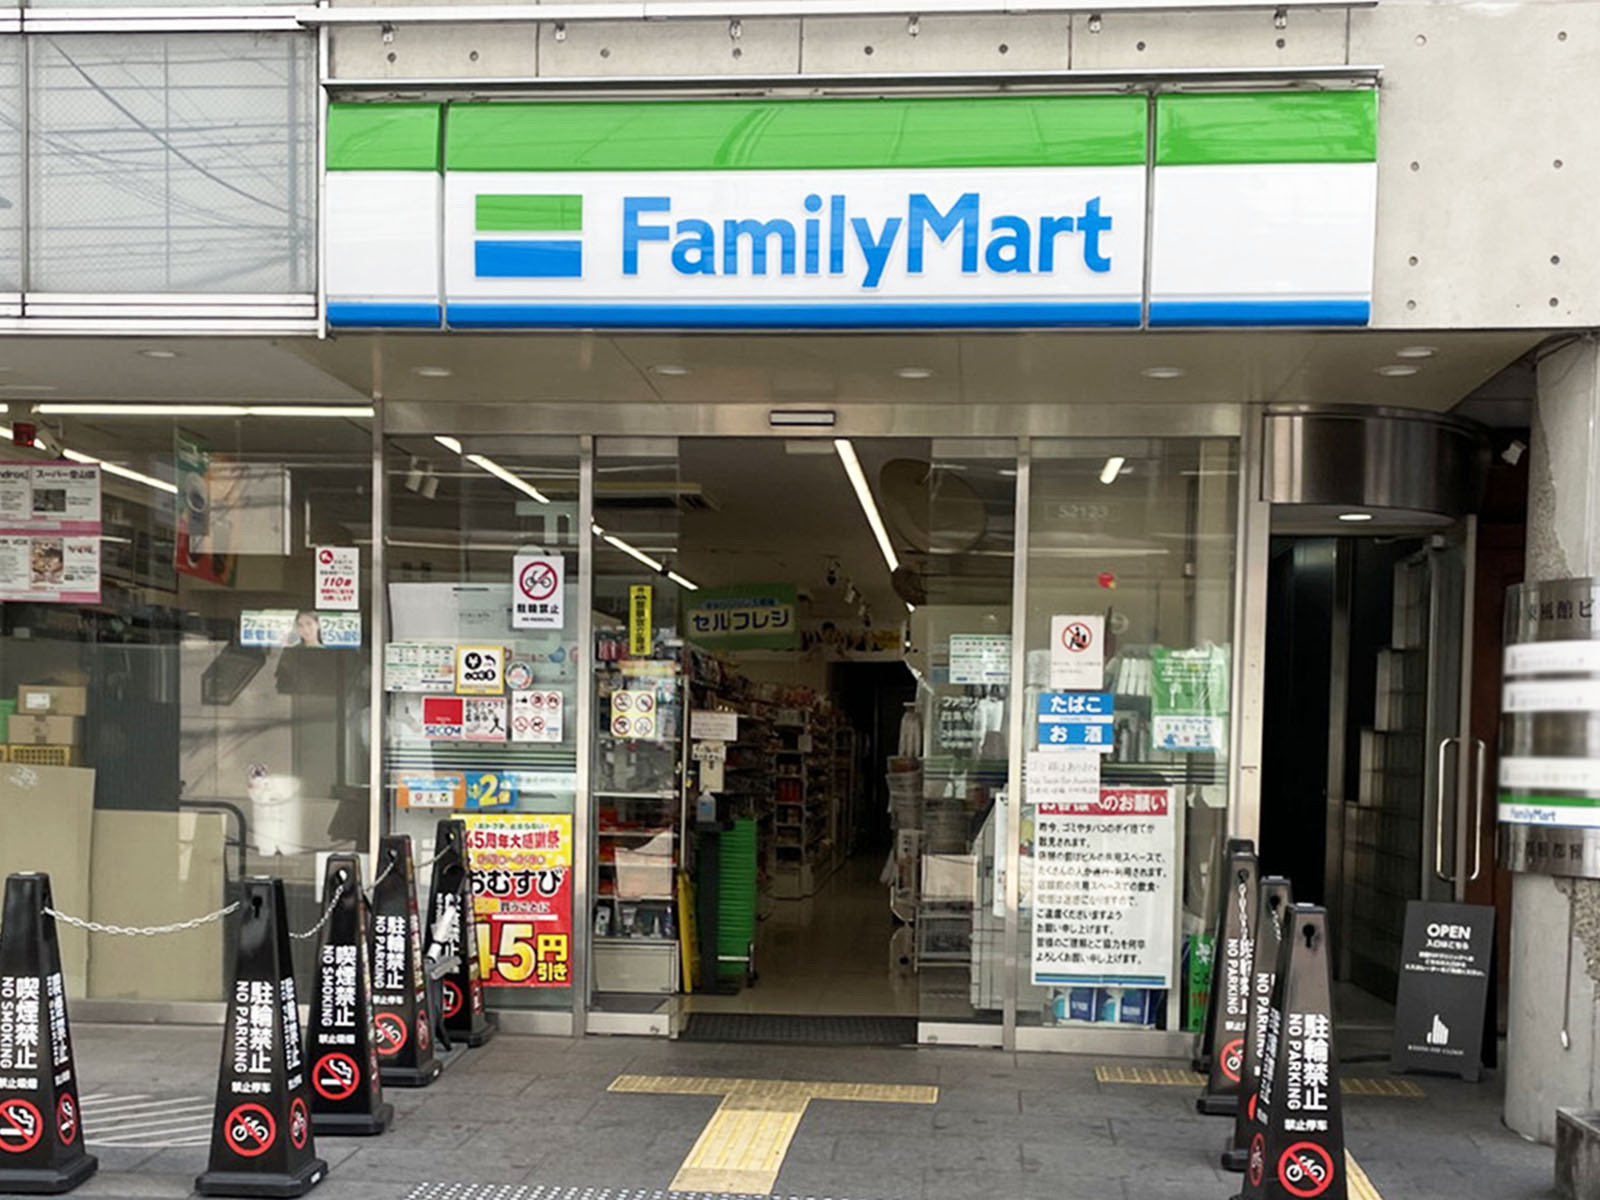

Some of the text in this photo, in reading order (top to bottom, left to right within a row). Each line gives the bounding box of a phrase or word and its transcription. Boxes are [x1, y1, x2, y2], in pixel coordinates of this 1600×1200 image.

[622, 193, 1113, 288] FamilyMart
[692, 608, 788, 632] セルフレジ
[424, 725, 462, 736] SECOM
[1049, 725, 1103, 743] お 酒
[1050, 695, 1102, 713] たばこ
[374, 915, 386, 990] NO PARKING
[385, 916, 406, 990] 駐輪禁止
[537, 933, 568, 962] 円
[1427, 923, 1471, 940] OPEN
[320, 945, 334, 1027] NO SMOKING
[334, 944, 356, 1027] 喫煙禁止
[537, 963, 568, 982] 引き
[1226, 939, 1239, 1015] NO PARKING
[1256, 972, 1270, 994] NO
[0, 976, 15, 1069] NO SMOKING
[14, 976, 40, 1069] 喫煙禁止
[233, 980, 249, 1073] NO PARKING
[248, 981, 274, 1073] 駐輪禁止
[1287, 1013, 1303, 1110] NO PARKING
[1303, 1013, 1330, 1111] 駐輪禁止
